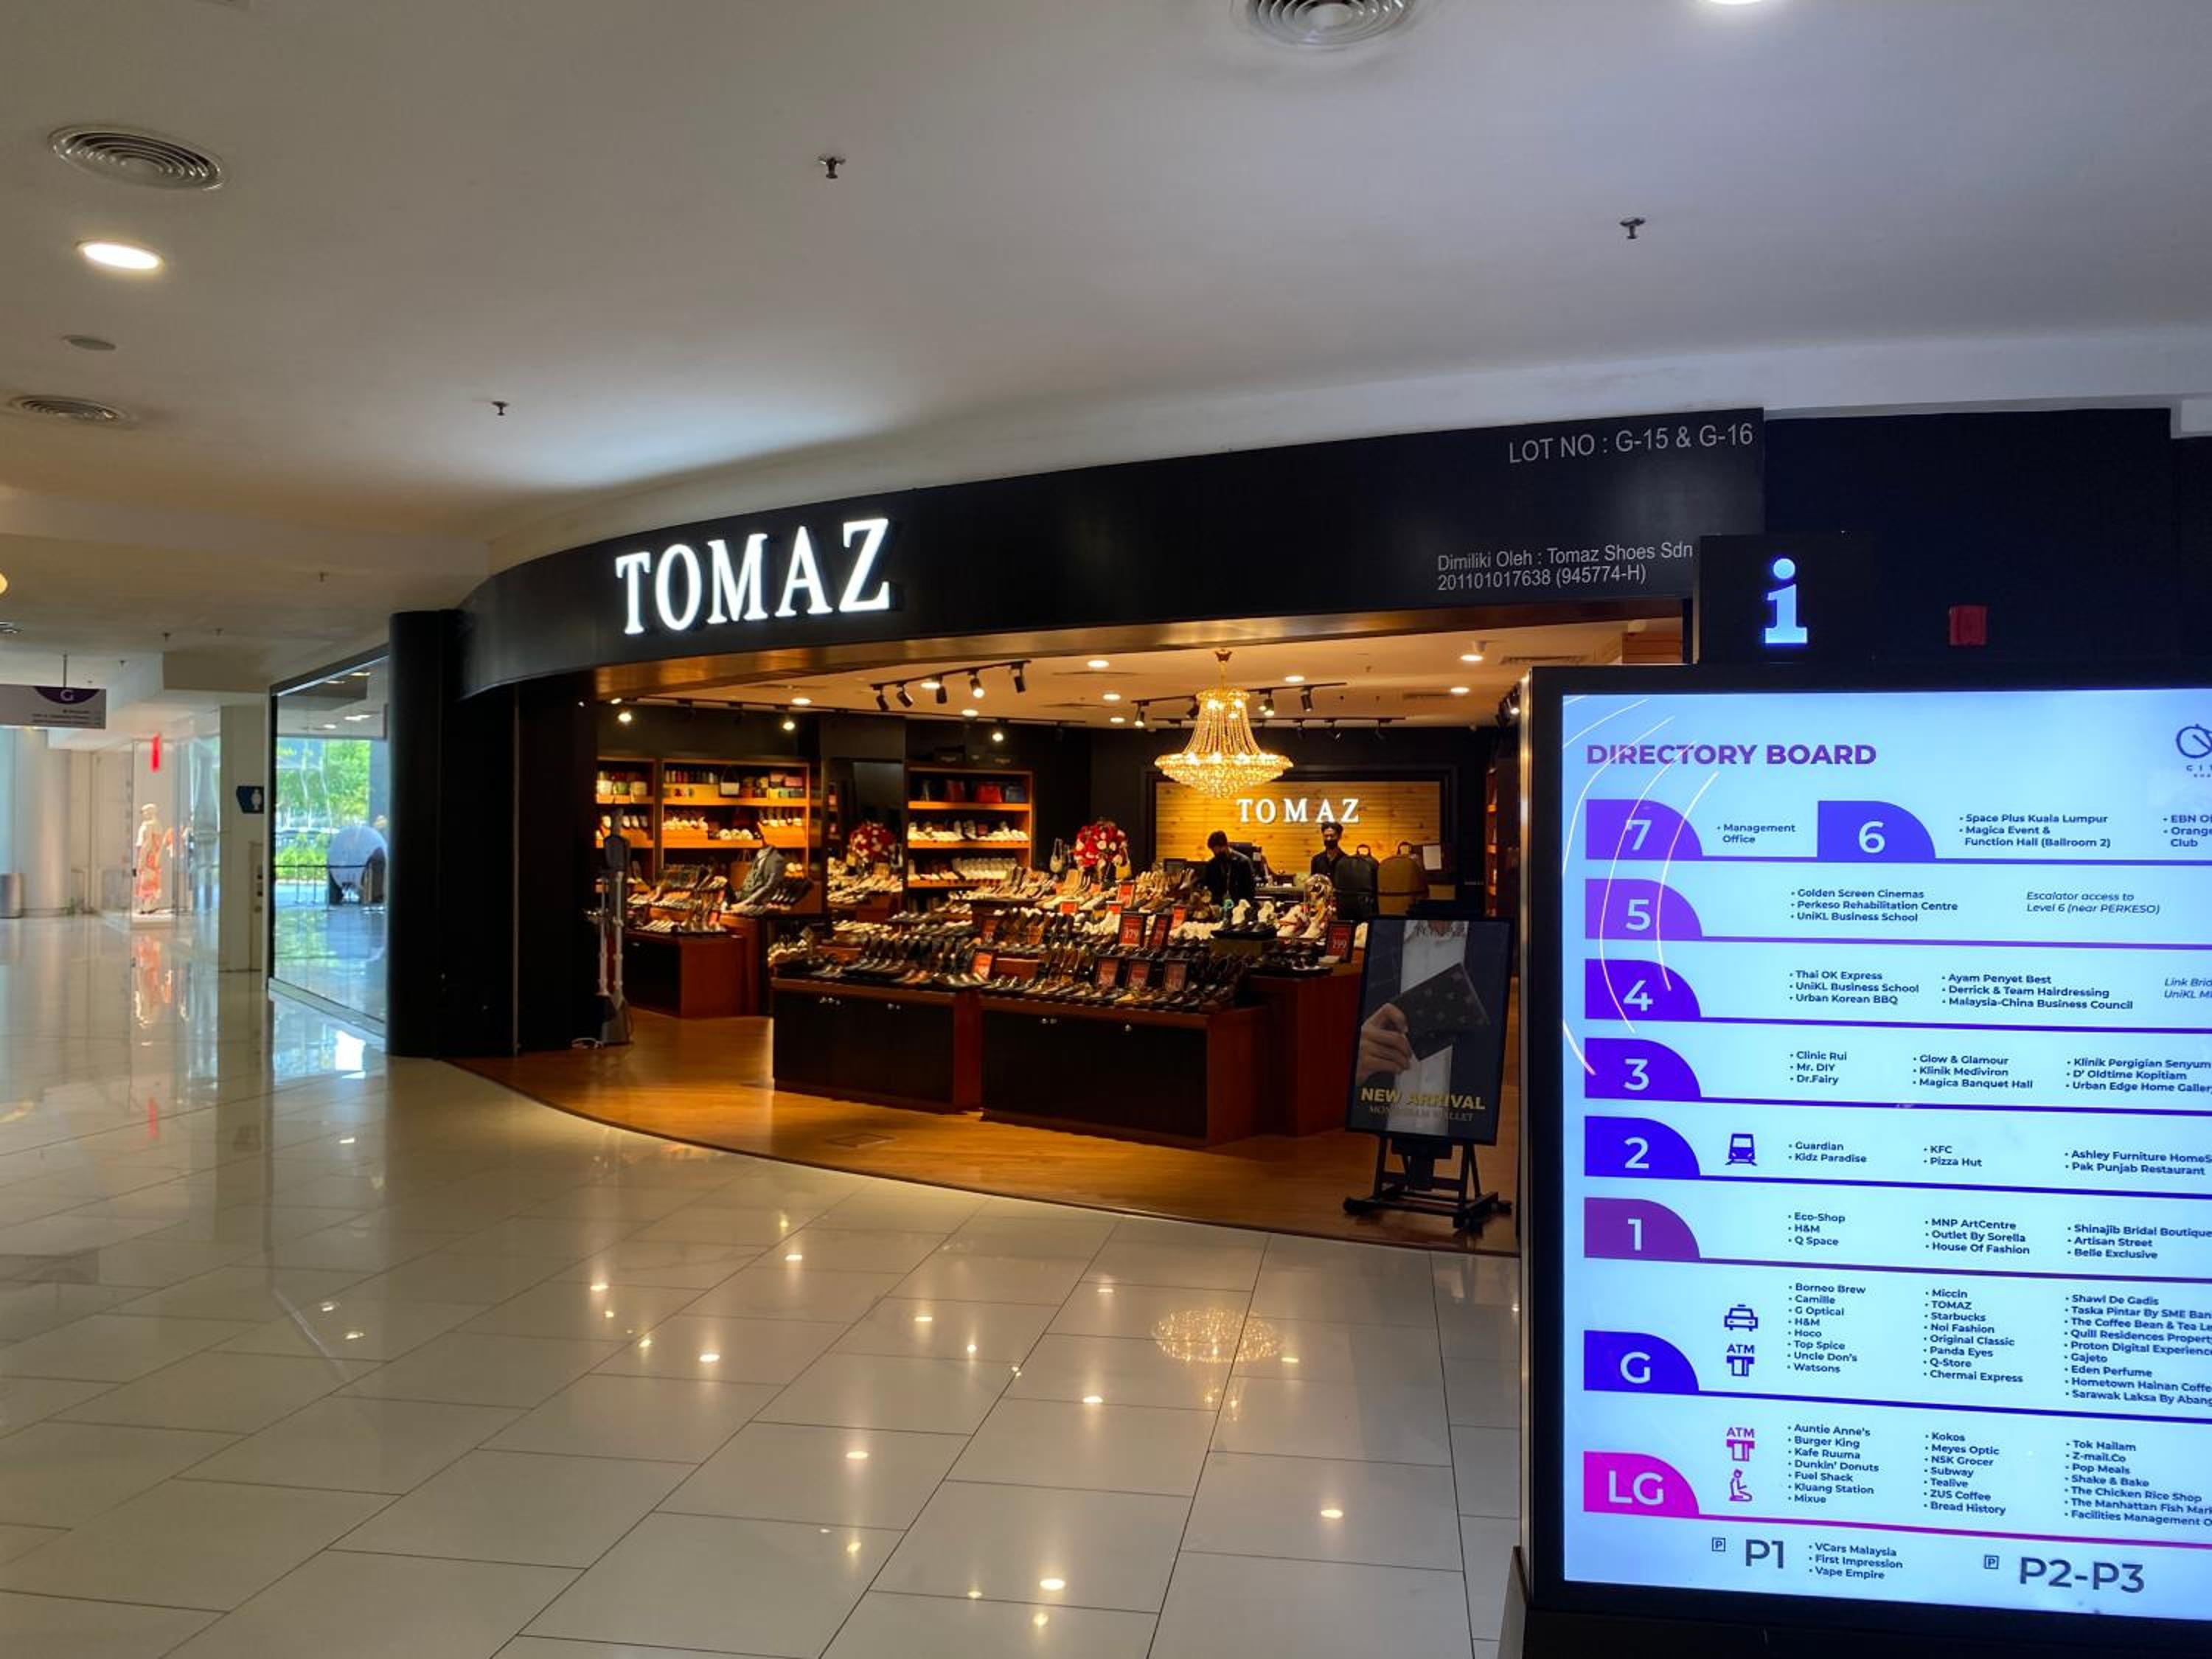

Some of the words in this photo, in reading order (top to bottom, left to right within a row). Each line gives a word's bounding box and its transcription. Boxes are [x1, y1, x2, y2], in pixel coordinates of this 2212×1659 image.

[1509, 437, 1553, 464] LOT
[1561, 434, 1595, 458] NO
[1615, 428, 1669, 453] G-15
[1675, 426, 1691, 448] &
[1700, 422, 1753, 448] G-16
[1438, 552, 1491, 572] Dimiliki
[1496, 550, 1533, 568] Oleh
[1547, 547, 1599, 564] Tomaz
[1604, 544, 1655, 562] Shoes
[1660, 541, 1693, 559] Sdn
[615, 517, 891, 635] TOMAZ
[1438, 569, 1551, 591] 201101017638
[1556, 563, 1646, 588] (945774-H)
[60, 689, 74, 702] G
[1586, 744, 1758, 765] DIRECTORY
[1766, 744, 1877, 765] BOARD
[1236, 798, 1360, 824] TOMAZ
[1966, 814, 1999, 824] Space
[2000, 814, 2025, 823] Plus
[2028, 814, 2059, 823] Kuala
[2062, 815, 2108, 824] Lumpur
[1626, 819, 1652, 850] 7
[1723, 824, 1796, 833] Management
[1966, 826, 2005, 836] Magica
[2008, 826, 2040, 835] Event
[2042, 826, 2051, 835] &
[1722, 834, 1756, 844] Office
[1858, 820, 1886, 854] 6
[1964, 838, 2014, 846] Function
[2017, 838, 2039, 846] Hall
[2041, 838, 2097, 848] (Ballroom
[2100, 838, 2111, 848] 2)
[1798, 888, 1835, 897] Golden
[1837, 889, 1875, 897] Screen
[1877, 889, 1924, 898] Cinemas
[1798, 900, 1841, 909] Perkeso
[1843, 900, 1919, 910] Rehabilitation
[1921, 902, 1958, 911] Centre
[1626, 899, 1651, 931] 5
[1797, 911, 1829, 920] UniKL
[1831, 912, 1879, 920] Business
[1881, 913, 1918, 922] School
[1795, 970, 1819, 978] Thai
[1821, 970, 1838, 979] OK
[1840, 971, 1883, 981] Express
[1948, 973, 1980, 984] Ayam
[1983, 974, 2024, 985] Penyet
[2025, 975, 2051, 984] Best
[1623, 980, 1654, 1012] 4
[1795, 993, 1829, 1002] Urban
[1831, 995, 1871, 1003] Korean
[1872, 995, 1898, 1005] BBQ
[1949, 997, 2034, 1008] Malaysia-China
[2037, 999, 2087, 1009] Business
[2090, 1001, 2133, 1009] Council
[1795, 1051, 1826, 1060] Clinic
[1919, 1054, 1948, 1063] Glow
[1950, 1055, 1958, 1063] &
[1961, 1056, 2009, 1065] Glamour
[1795, 1062, 1814, 1071] Mr.
[1816, 1063, 1835, 1071] DIY
[1919, 1066, 1951, 1075] Klinik
[1953, 1067, 2008, 1077] Mediviron
[1624, 1058, 1649, 1091] 3
[1919, 1078, 1958, 1088] Magica
[1961, 1079, 2009, 1089] Banquet
[2011, 1079, 2033, 1088] Hall
[1361, 1088, 1402, 1104] NEW
[1407, 1091, 1486, 1110] ARRIVAL
[1795, 1141, 1844, 1150] Guardian
[1930, 1145, 1952, 1154] KFC
[1624, 1137, 1649, 1169] 2
[1795, 1152, 1818, 1161] Kidz
[1820, 1153, 1867, 1163] Paradise
[1930, 1156, 1959, 1166] Pizza
[1961, 1158, 1982, 1166] Hut
[2072, 1161, 2094, 1171] Pak
[2096, 1163, 2138, 1174] Punjab
[2140, 1164, 2206, 1175] Restaurant
[1794, 1212, 1846, 1224] Eco-Shop
[1931, 1218, 1958, 1227] MNP
[1961, 1220, 2017, 1230] ArtCentre
[1794, 1224, 1820, 1233] H&M
[1627, 1219, 1643, 1251] 1
[1794, 1236, 1804, 1245] Q
[1806, 1237, 1839, 1246] Space
[1931, 1230, 1968, 1239] Outlet
[1970, 1231, 1986, 1244] By
[1987, 1233, 2026, 1242] Sorella
[1932, 1242, 1968, 1251] House
[1970, 1243, 1984, 1252] Of
[1986, 1245, 2030, 1254] Fashion
[1795, 1295, 1836, 1304] Camille
[1931, 1301, 1972, 1310] TOMAZ
[1806, 1307, 1845, 1317] Optical
[1930, 1312, 1986, 1321] Starbucks
[1794, 1318, 1820, 1326] H&M
[1726, 1344, 1755, 1355] ATM
[1793, 1340, 1814, 1350] Top
[1816, 1340, 1846, 1351] Spice
[1794, 1352, 1825, 1360] Uncle
[1827, 1352, 1857, 1362] Don's
[1930, 1346, 1965, 1356] Panda
[1968, 1348, 1994, 1359] Eyes
[1620, 1352, 1652, 1384] G
[1930, 1357, 1972, 1368] Q-Store
[2071, 1365, 2101, 1374] Eden
[2102, 1366, 2153, 1377] Perfume
[1726, 1427, 1755, 1439] ATM
[1794, 1424, 1830, 1433] Auntie
[1832, 1426, 1871, 1436] Anne's
[1931, 1432, 1966, 1441] Kokos
[1794, 1436, 1832, 1447] Burger
[1834, 1438, 1860, 1450] King
[1931, 1444, 1966, 1455] Meyes
[1969, 1446, 2000, 1455] Optic
[1795, 1459, 1837, 1470] Dunkin'
[1840, 1462, 1879, 1472] Donuts
[1930, 1455, 1954, 1464] NSK
[1956, 1456, 1994, 1466] Grocer
[1794, 1471, 1818, 1480] Fuel
[1820, 1472, 1854, 1482] Shack
[1930, 1467, 1975, 1478] Subway
[1608, 1470, 1664, 1506] LG
[1794, 1483, 1833, 1494] Kluang
[1835, 1484, 1874, 1494] Station
[1794, 1493, 1826, 1503] Mixue
[1930, 1489, 1952, 1498] ZUS
[1955, 1490, 1992, 1501] Coffee
[1930, 1501, 1964, 1512] Bread
[1966, 1503, 2006, 1516] History
[1745, 1539, 1784, 1569] P1
[1815, 1543, 1847, 1553] VCars
[1849, 1545, 1896, 1559] Malaysia
[1815, 1554, 1840, 1565] First
[1842, 1557, 1903, 1568] Impression
[1815, 1566, 1843, 1577] Vape
[1846, 1568, 1885, 1579] Empire
[2020, 1557, 2146, 1593] P2-P3
